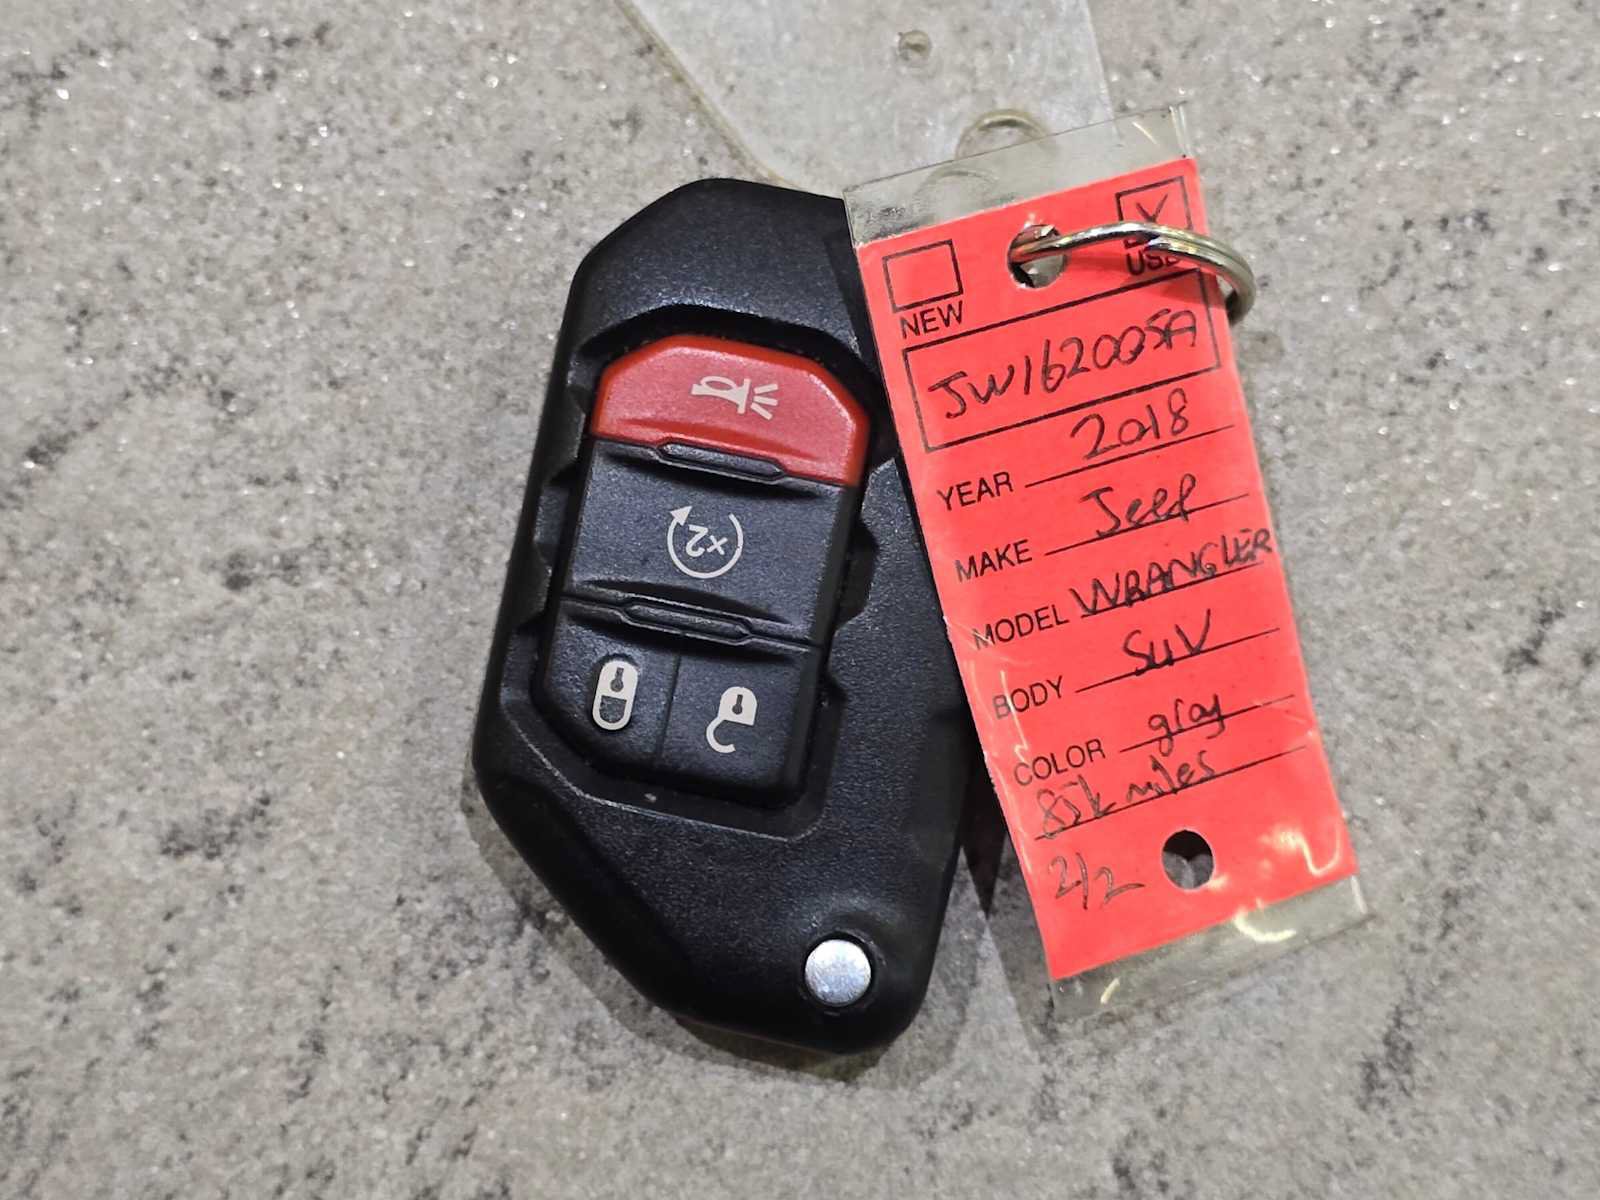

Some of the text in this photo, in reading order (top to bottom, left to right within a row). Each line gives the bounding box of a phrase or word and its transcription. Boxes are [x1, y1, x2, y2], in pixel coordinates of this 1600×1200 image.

[901, 301, 964, 339] NEW
[937, 388, 1190, 511] YEAR 2018
[954, 473, 1197, 583] MAKE Jeep
[972, 528, 1273, 651] MODEL WRANGLER
[992, 675, 1067, 719] BODY
[1013, 694, 1226, 785] COLOR gray
[1126, 750, 1217, 795] miles
